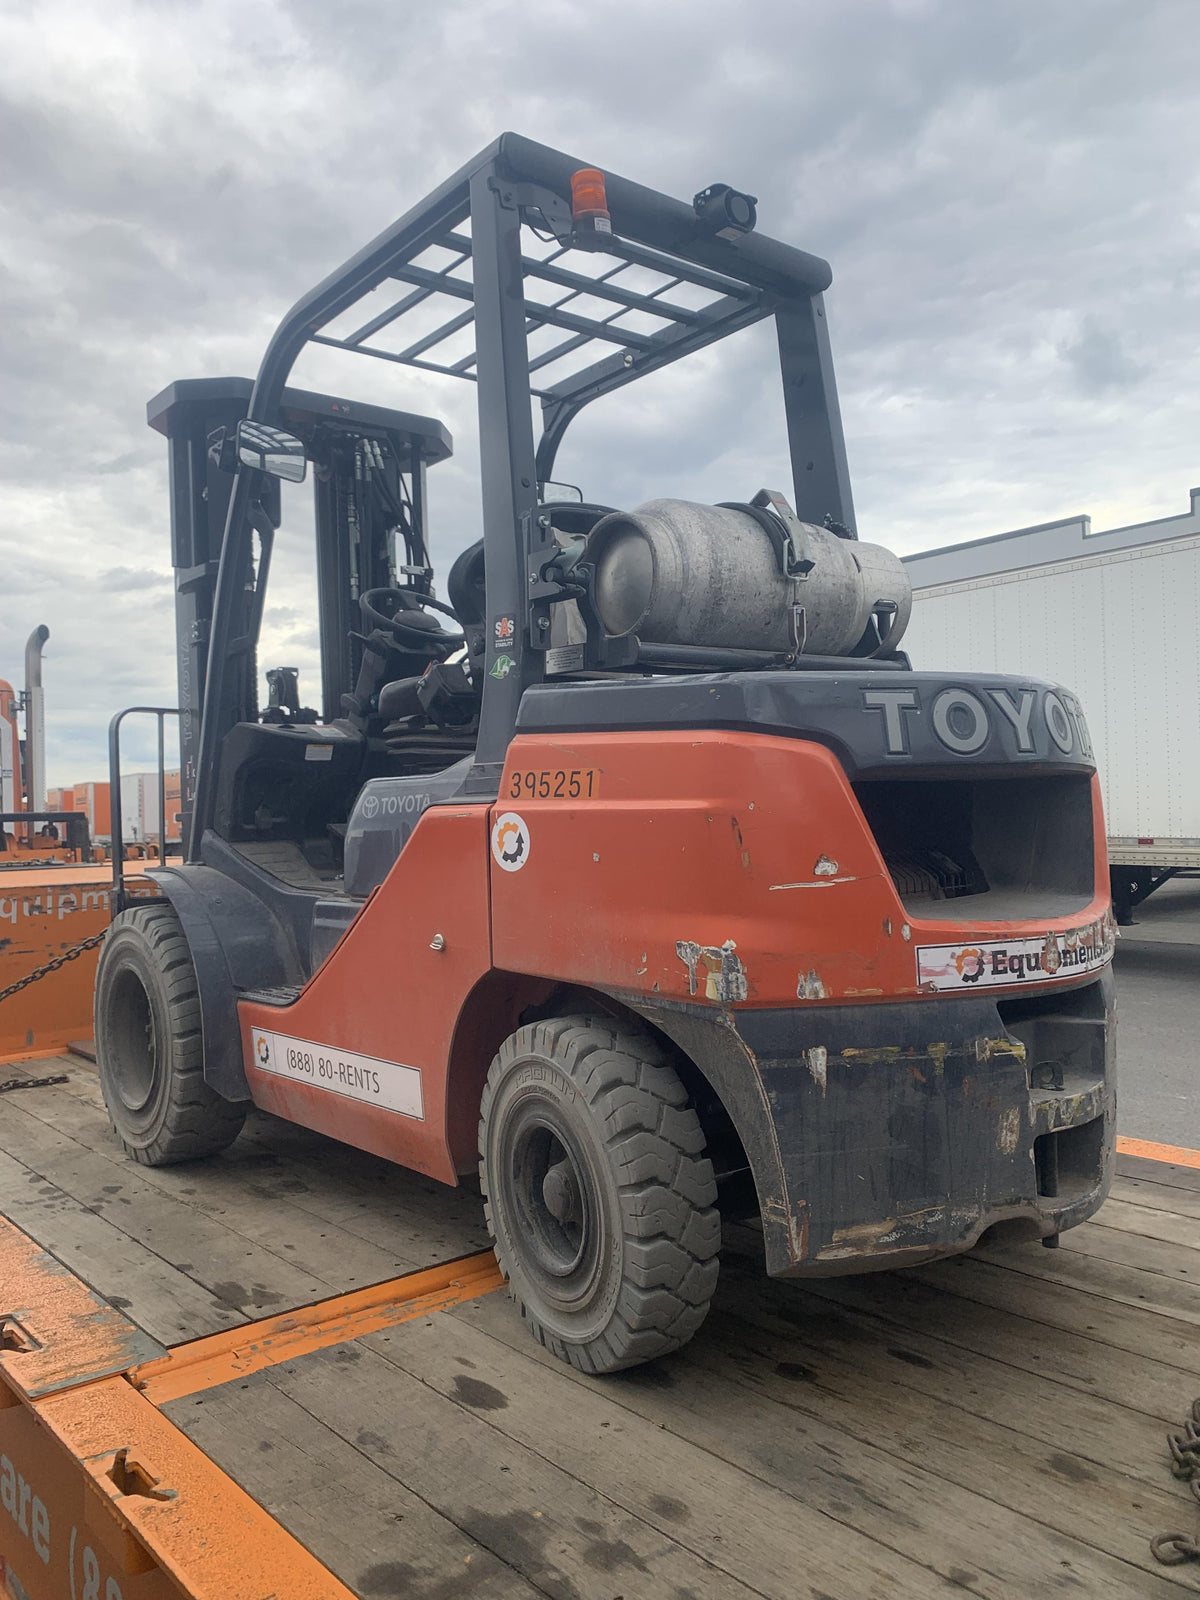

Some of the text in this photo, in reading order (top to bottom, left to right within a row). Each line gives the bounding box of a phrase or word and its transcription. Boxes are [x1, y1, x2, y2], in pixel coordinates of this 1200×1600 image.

[494, 617, 515, 638] SAS
[510, 770, 594, 799] 395251
[381, 794, 431, 815] TOYOTA
[286, 1047, 381, 1094] (888) 80-RENTS
